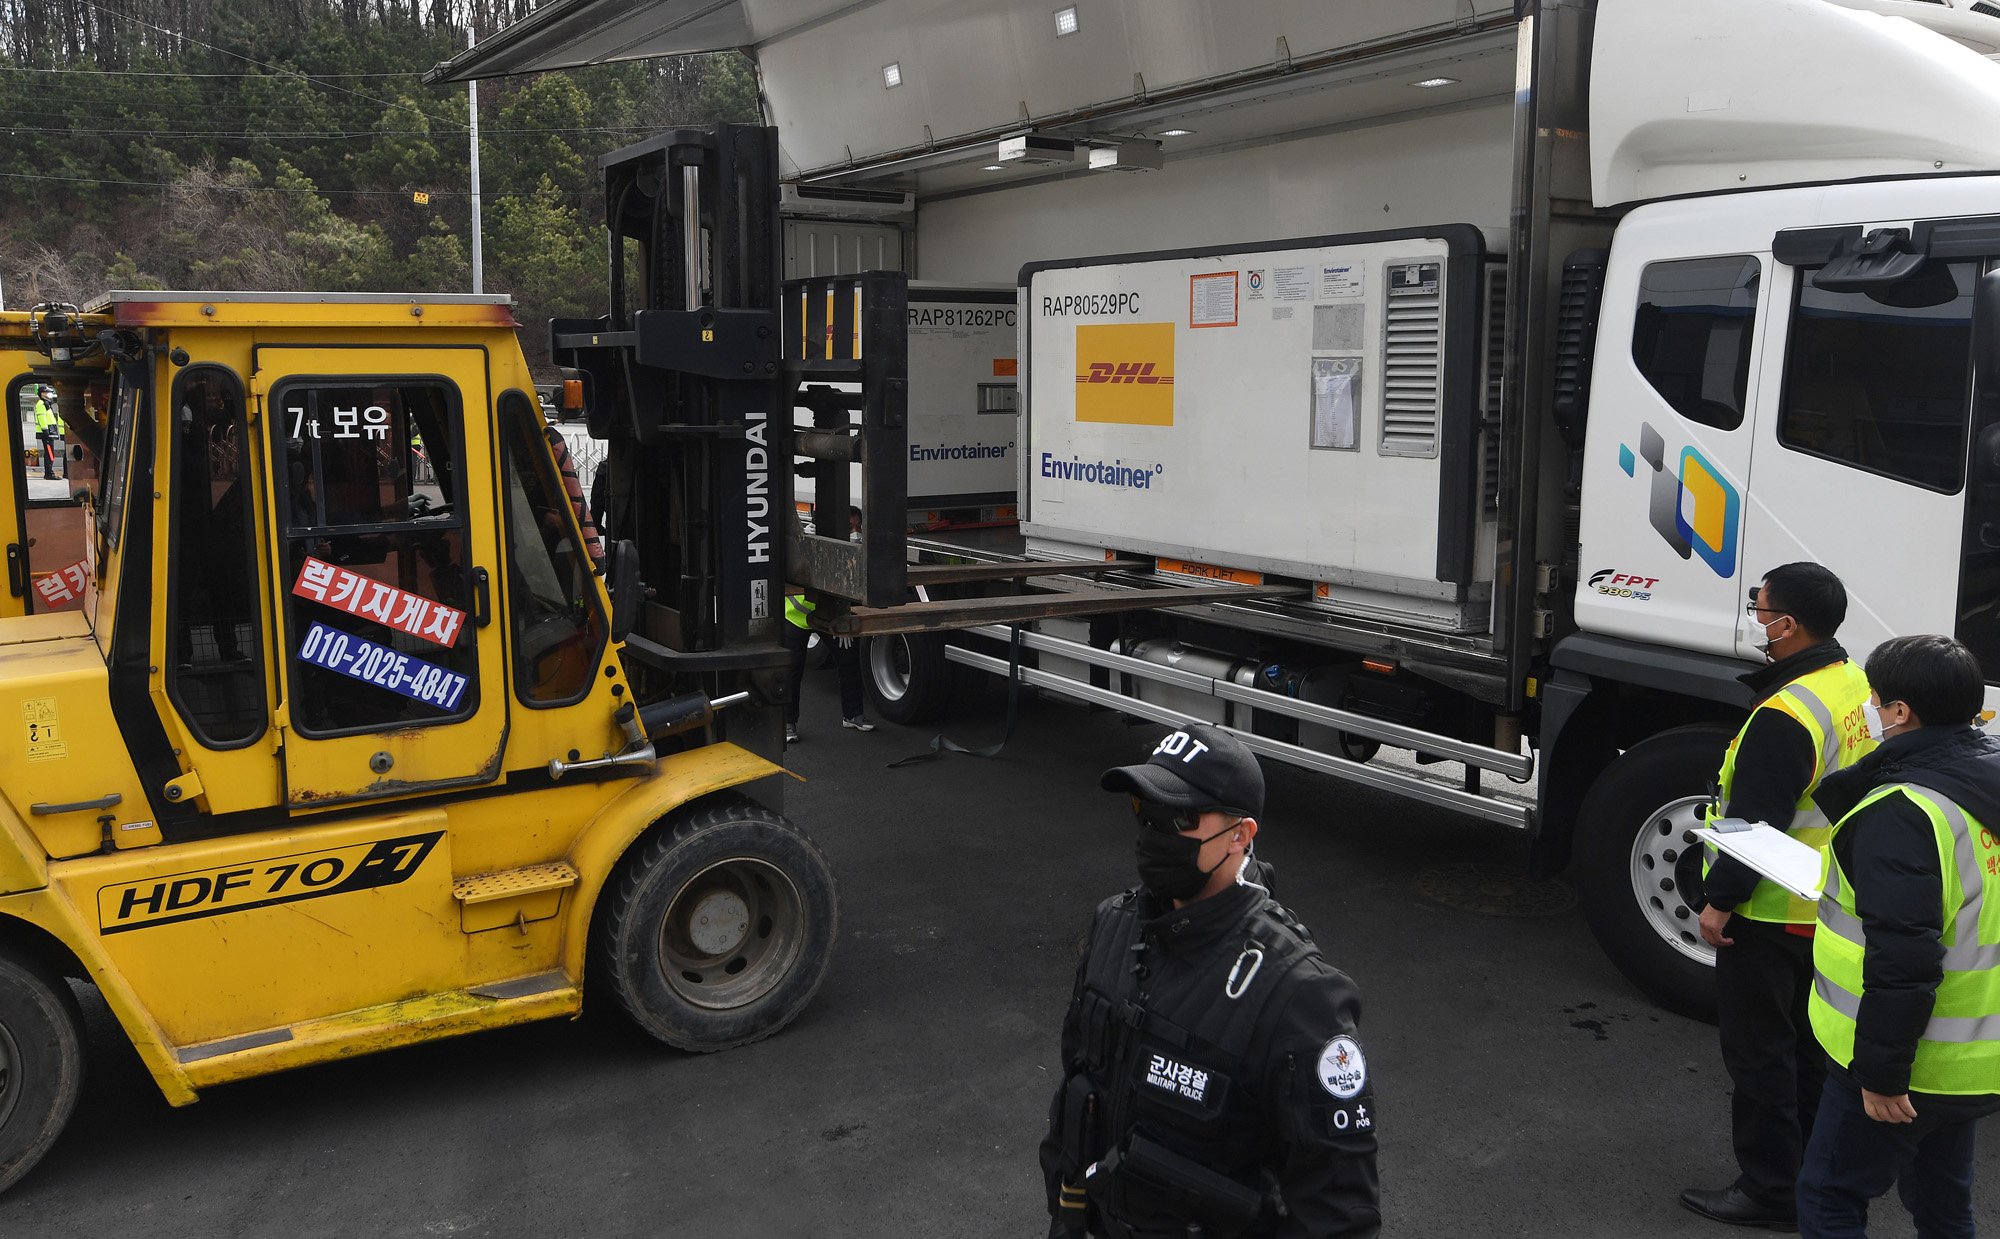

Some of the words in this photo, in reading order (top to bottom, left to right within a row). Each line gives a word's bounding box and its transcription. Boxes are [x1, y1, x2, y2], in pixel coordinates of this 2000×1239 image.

[908, 308, 1016, 327] RAP81262PC
[1043, 292, 1140, 316] RAP80529PC
[1087, 362, 1160, 384] DHL
[333, 406, 389, 440] 보유
[745, 412, 770, 563] HYUNDAI
[35, 560, 89, 602] 럭키
[1181, 563, 1209, 577] FORK
[1212, 568, 1235, 582] LIFT
[1611, 573, 1660, 589] FPT
[301, 559, 459, 645] 럭키지게차
[301, 625, 466, 708] 010-2025-4847
[1844, 704, 1866, 732] COVI
[118, 868, 254, 920] HDF
[1146, 1072, 1178, 1093] MILITARY
[1179, 1084, 1204, 1102] POLICE
[1150, 1054, 1209, 1092] 군사경찰
[1327, 1069, 1362, 1087] 백신수송
[1355, 1117, 1371, 1129] POS
